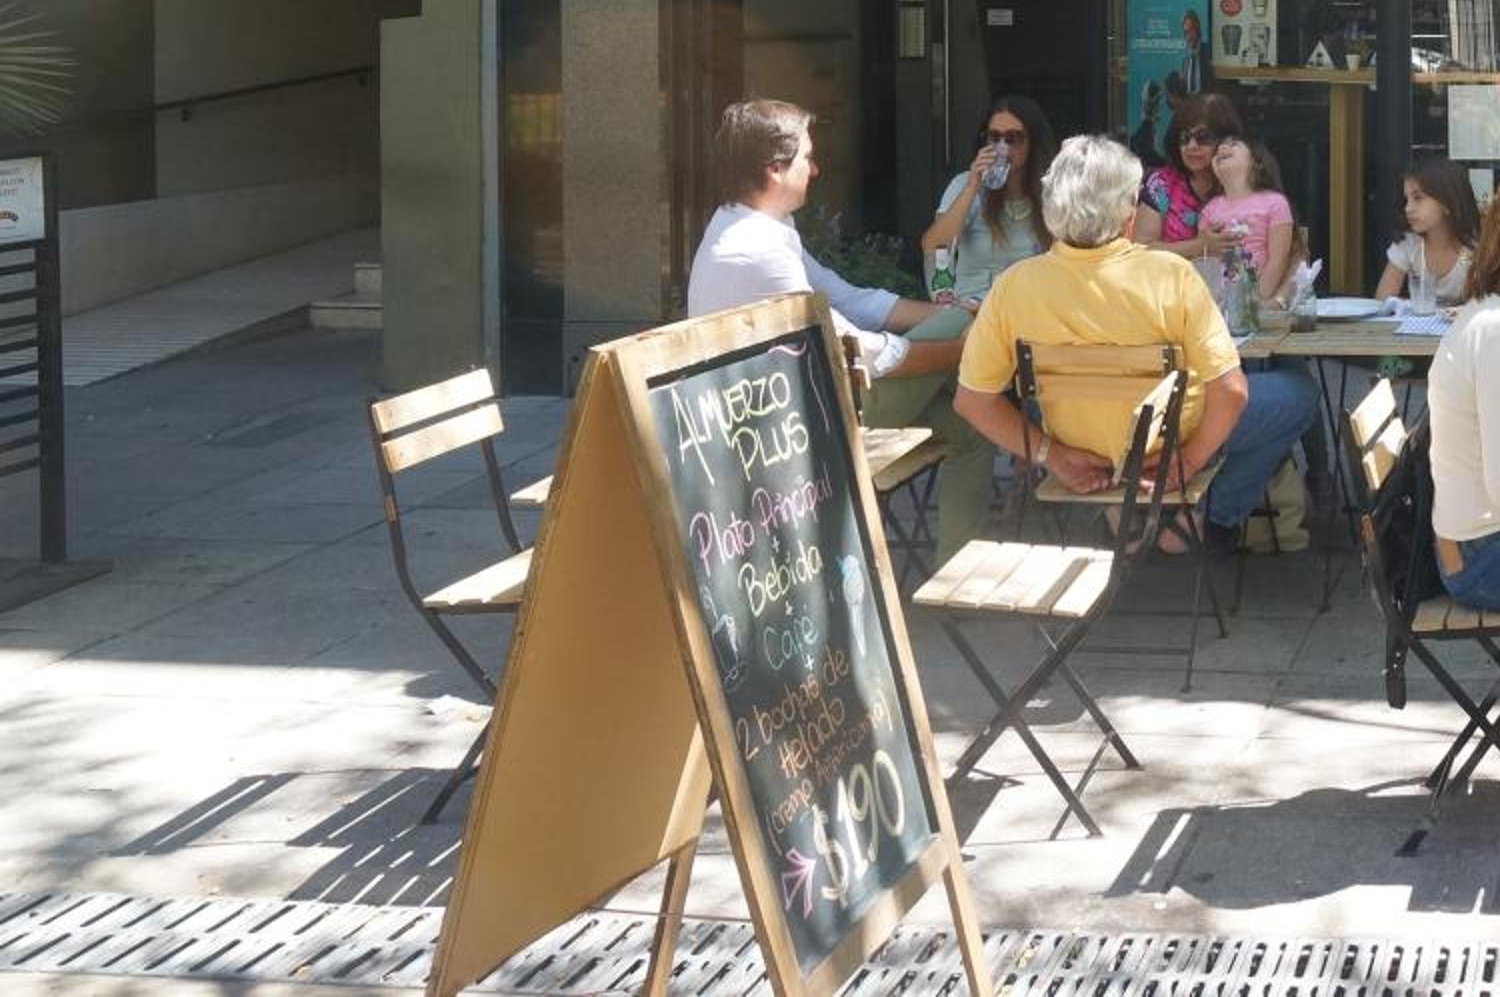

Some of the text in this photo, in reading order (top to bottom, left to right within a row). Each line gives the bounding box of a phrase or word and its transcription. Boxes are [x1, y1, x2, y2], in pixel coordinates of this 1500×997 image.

[671, 371, 791, 487] ALMUERZO
[731, 410, 810, 482] PLUS
[689, 511, 755, 578] Plato
[738, 538, 824, 617] Bebida
[735, 717, 760, 763] 2
[823, 644, 849, 687] de
[812, 748, 905, 909] $190
